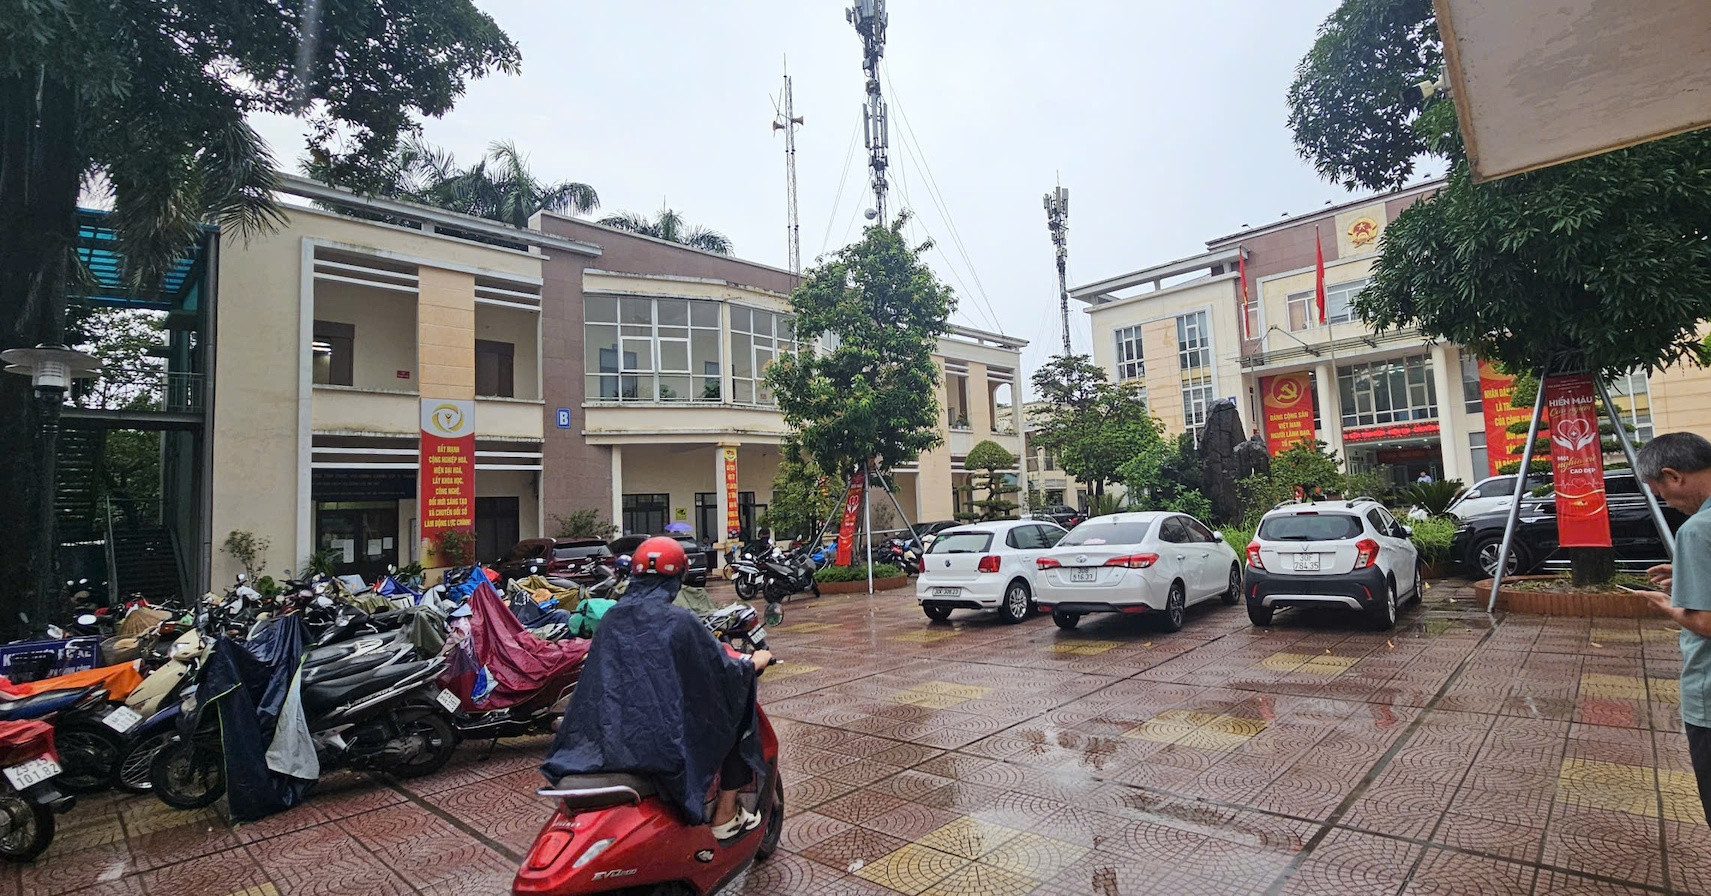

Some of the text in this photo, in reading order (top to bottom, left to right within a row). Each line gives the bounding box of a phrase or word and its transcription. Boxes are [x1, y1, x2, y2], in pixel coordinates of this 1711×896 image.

[1548, 396, 1592, 406] HIẾN MÁU
[559, 411, 569, 426] B
